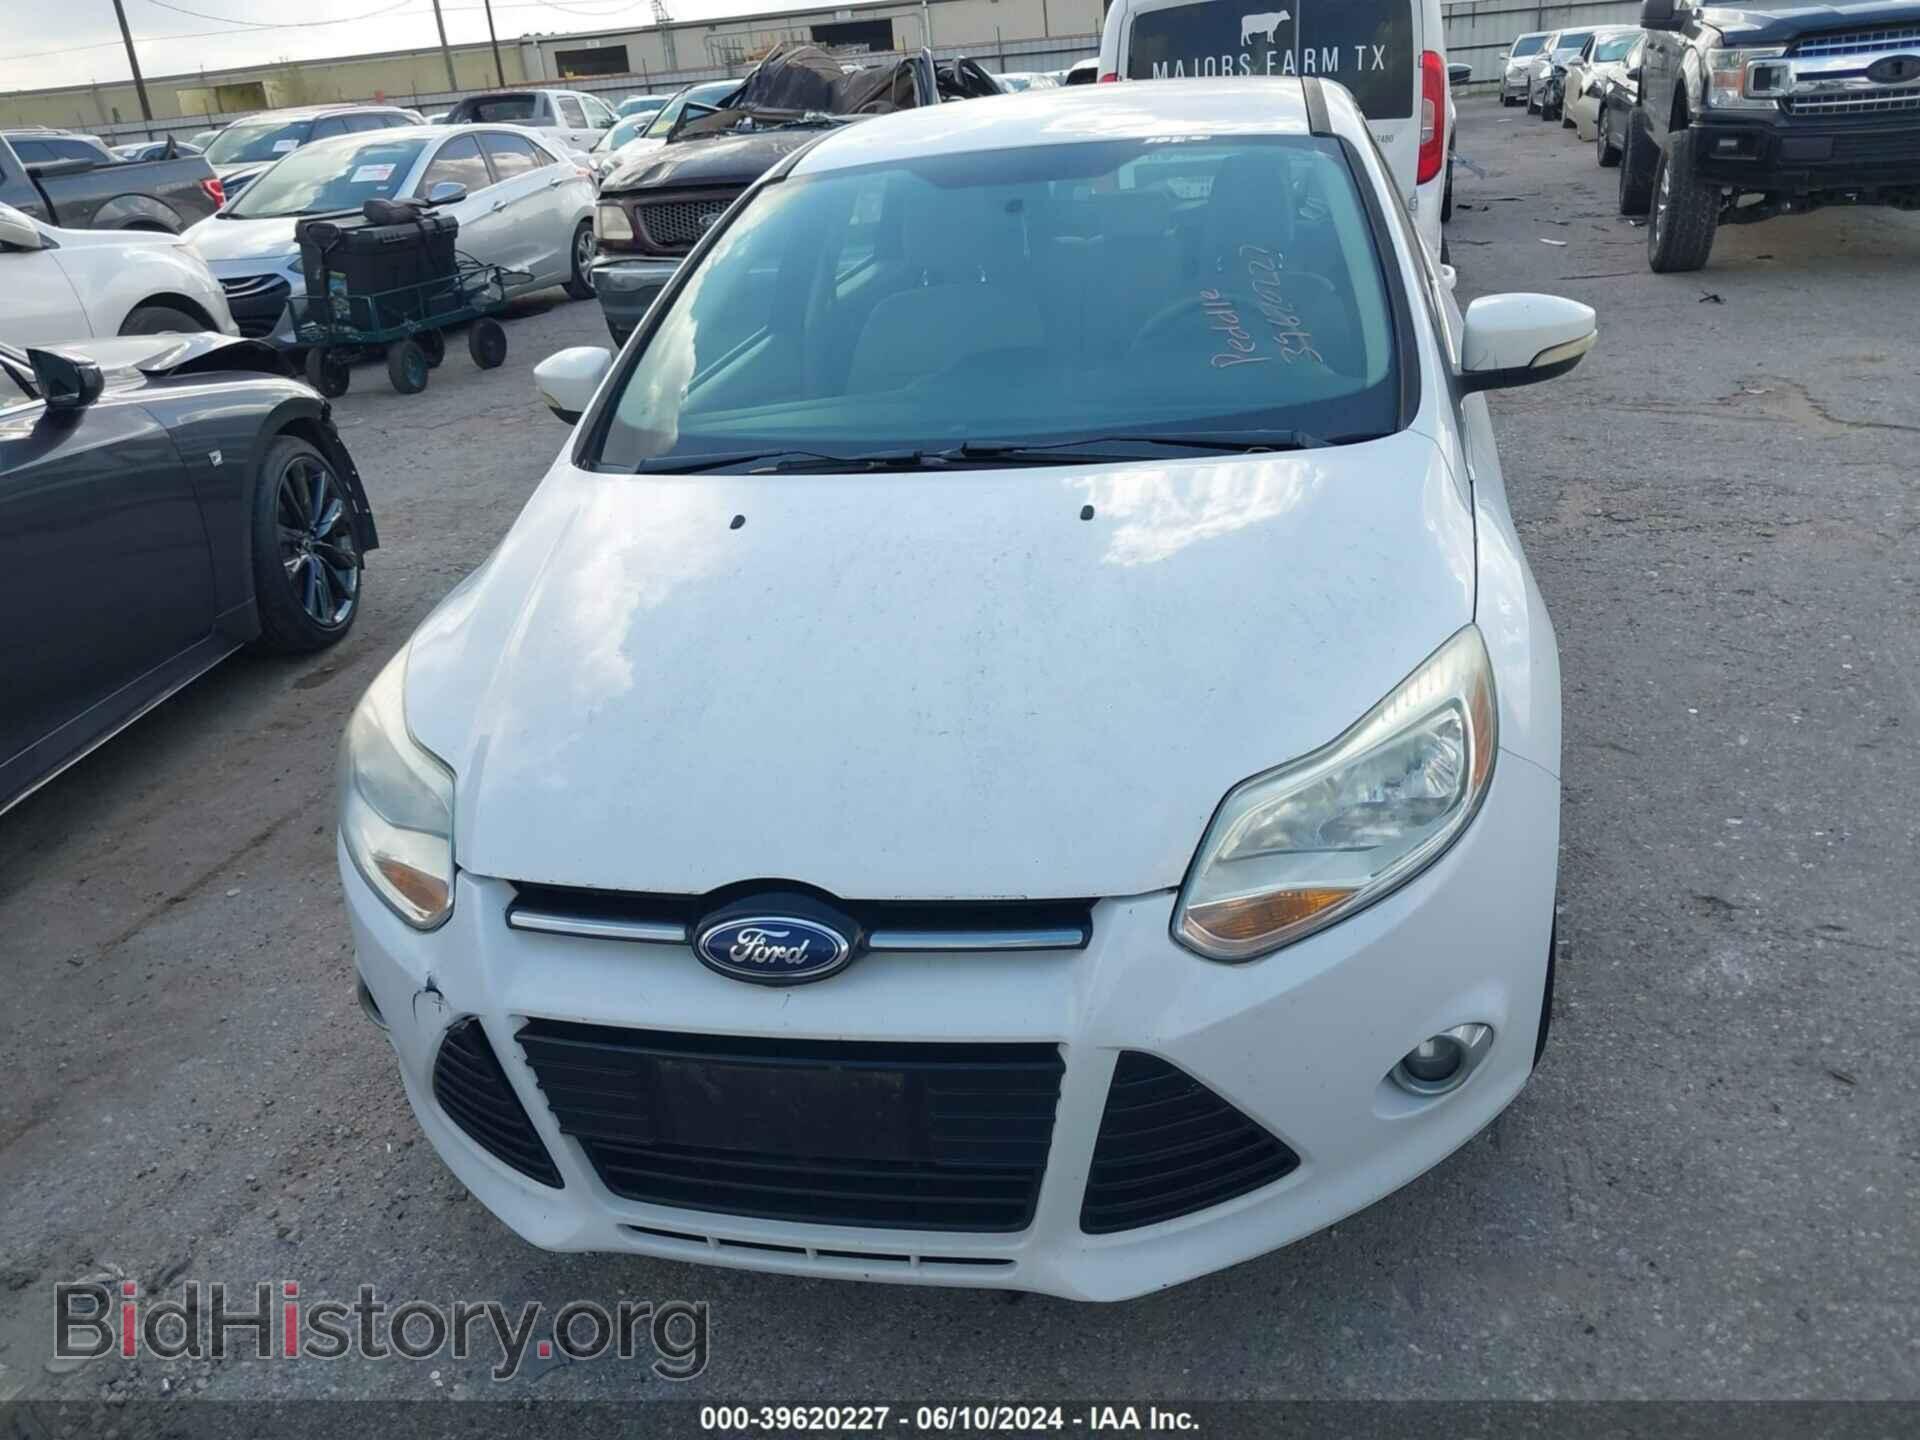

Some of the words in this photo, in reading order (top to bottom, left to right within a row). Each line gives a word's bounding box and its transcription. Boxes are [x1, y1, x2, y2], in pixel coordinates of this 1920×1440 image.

[1266, 46, 1339, 75] FARM
[1355, 45, 1385, 70] TX
[729, 928, 811, 964] Ford
